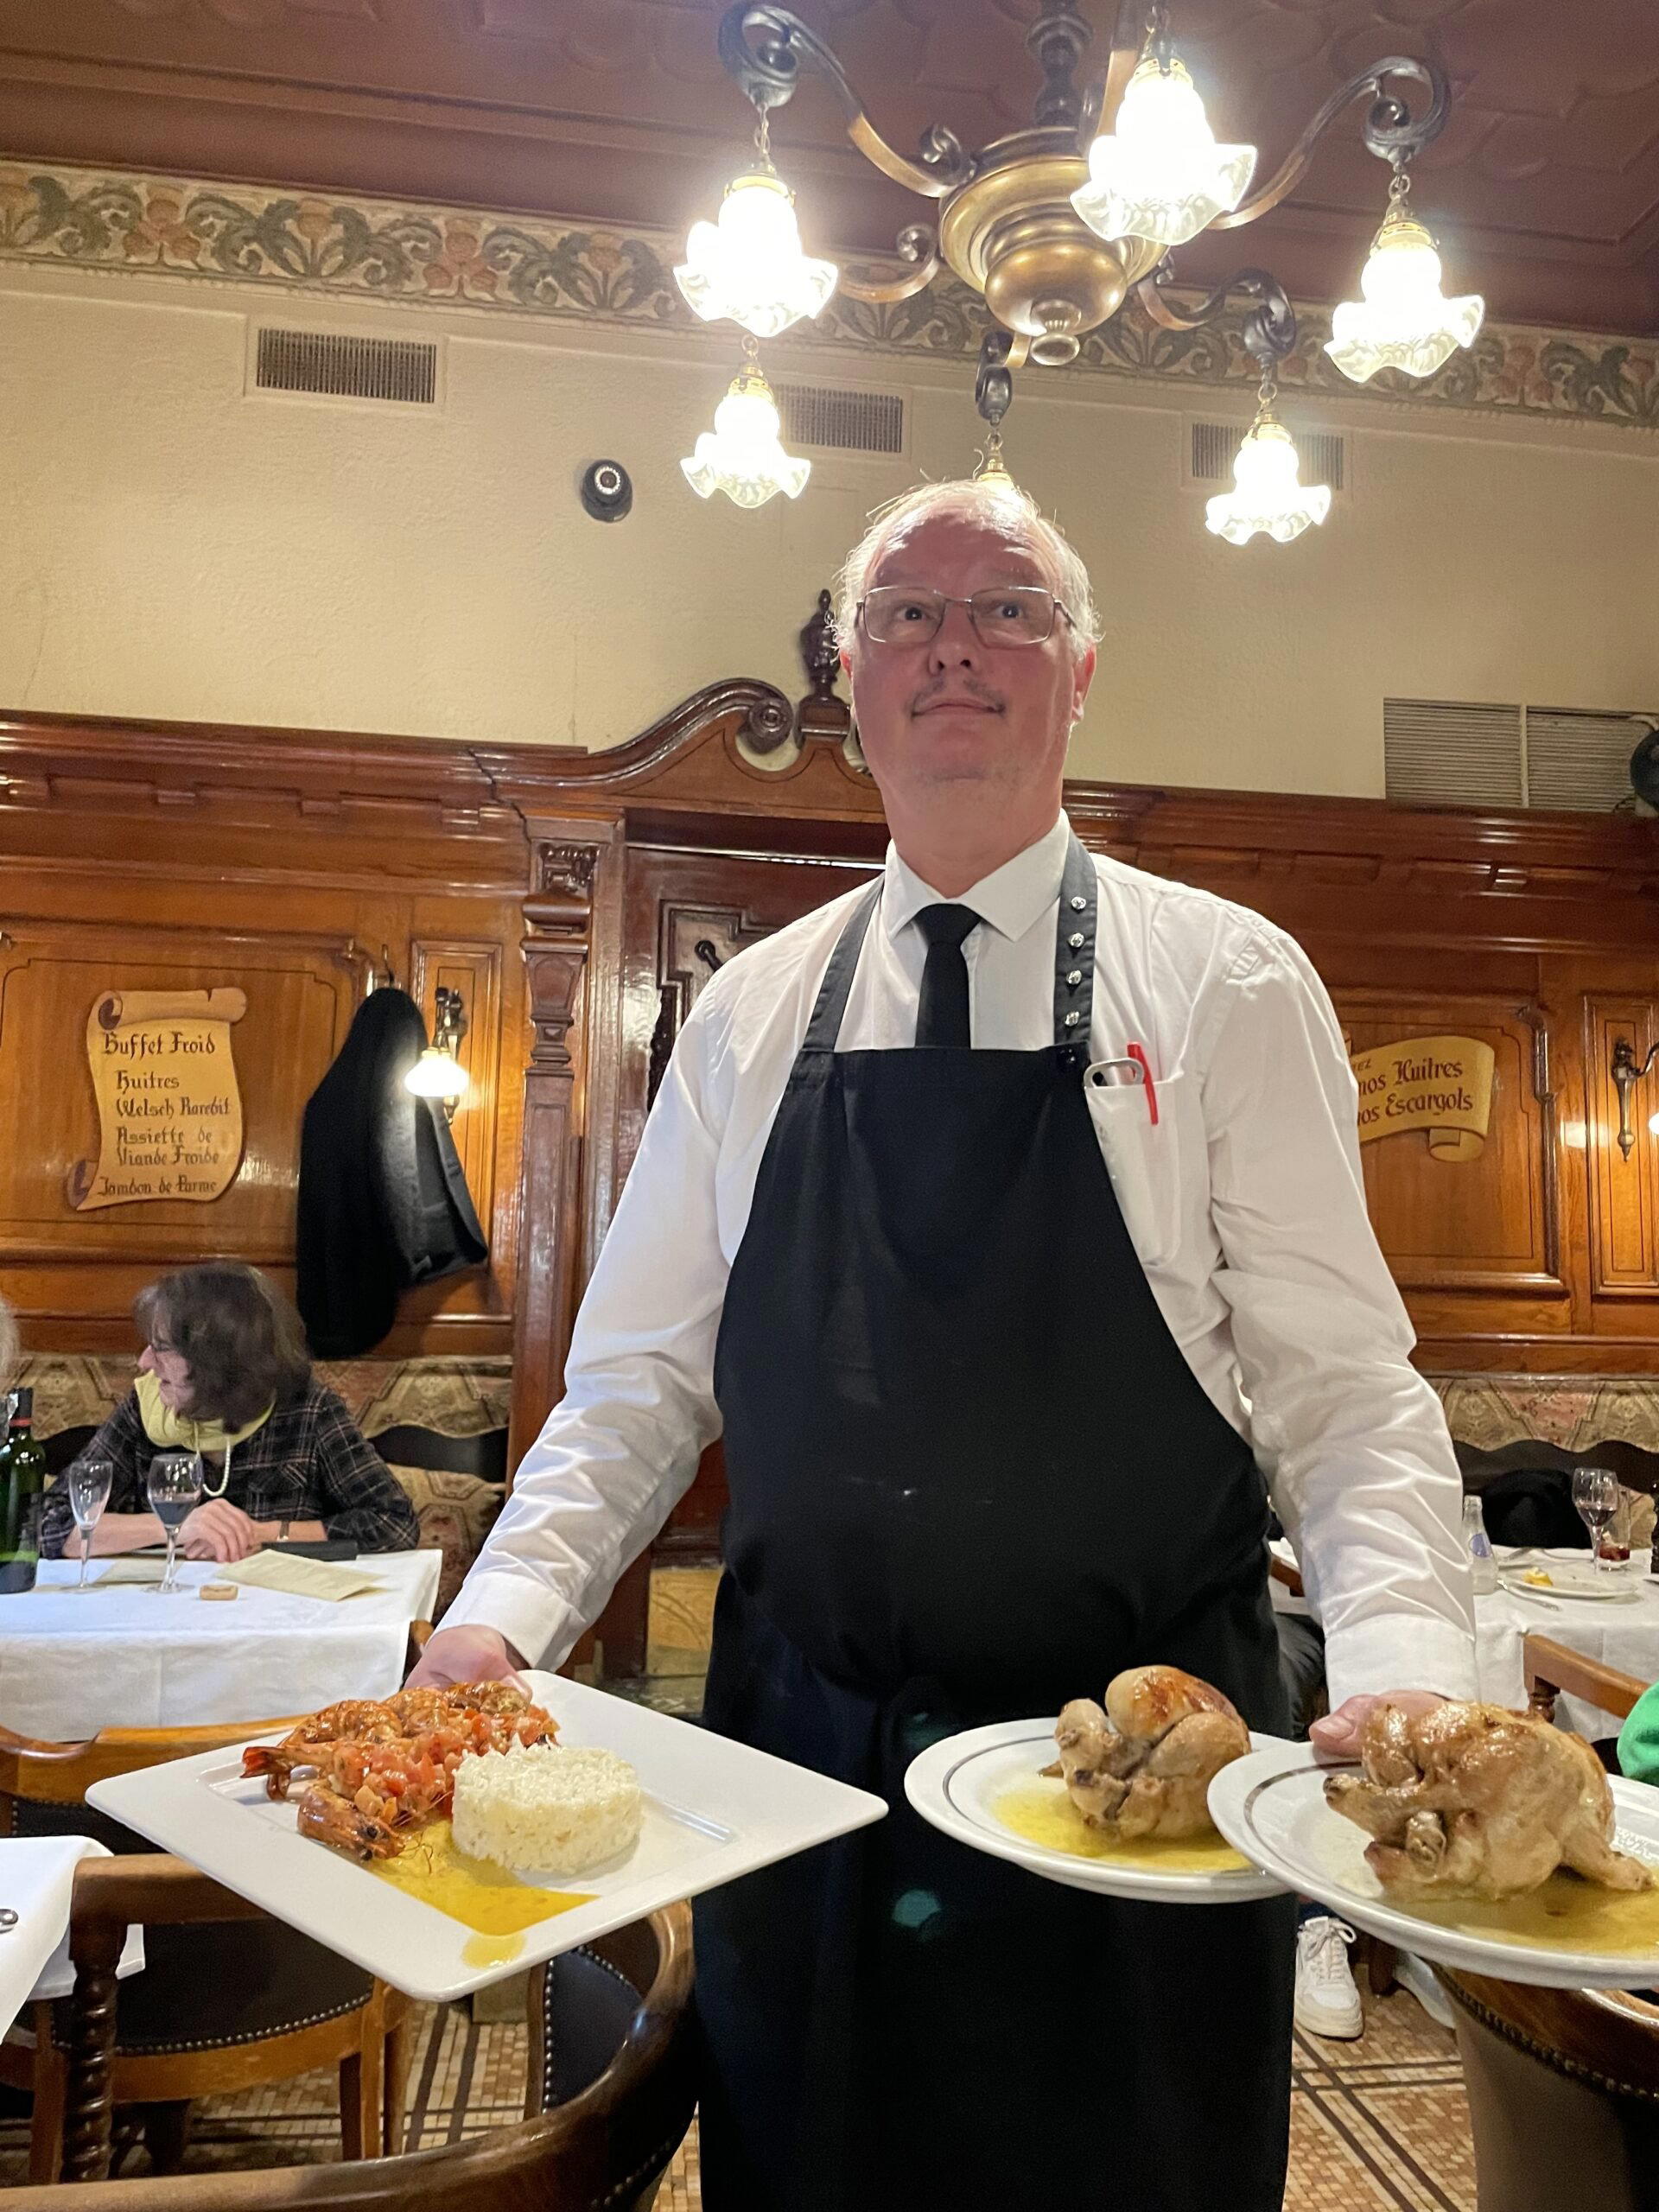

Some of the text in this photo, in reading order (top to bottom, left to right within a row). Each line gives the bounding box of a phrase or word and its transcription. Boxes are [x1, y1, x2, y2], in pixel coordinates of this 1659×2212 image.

[103, 1031, 215, 1059] Buffet Froid
[1392, 1058, 1463, 1085] Huitres
[116, 1070, 180, 1095] Huitres
[117, 1098, 174, 1119] Welsch
[117, 1126, 212, 1144] Assiette de
[117, 1145, 219, 1166] Viande Froide
[98, 1177, 151, 1196] Jambon
[158, 1176, 173, 1193] de
